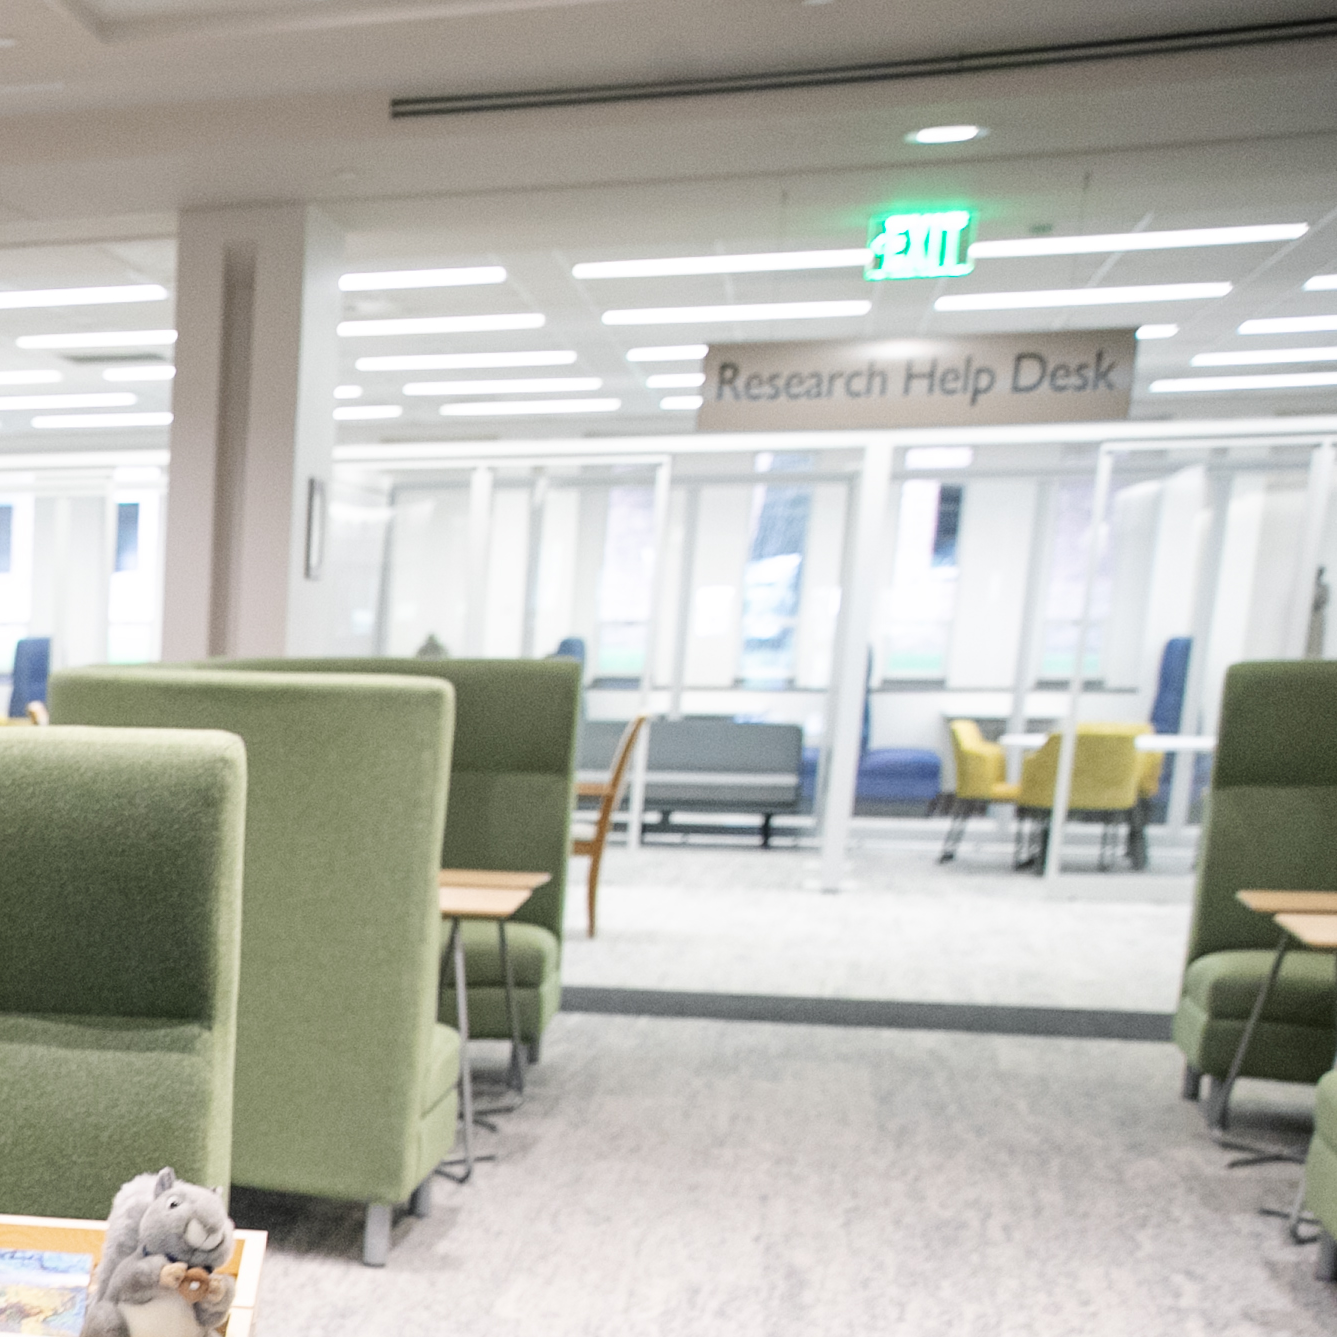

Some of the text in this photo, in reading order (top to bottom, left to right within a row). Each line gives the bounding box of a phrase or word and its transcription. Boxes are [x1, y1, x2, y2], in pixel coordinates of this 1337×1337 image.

[883, 210, 971, 278] EXIT
[714, 348, 1118, 407] Research Help Desk
